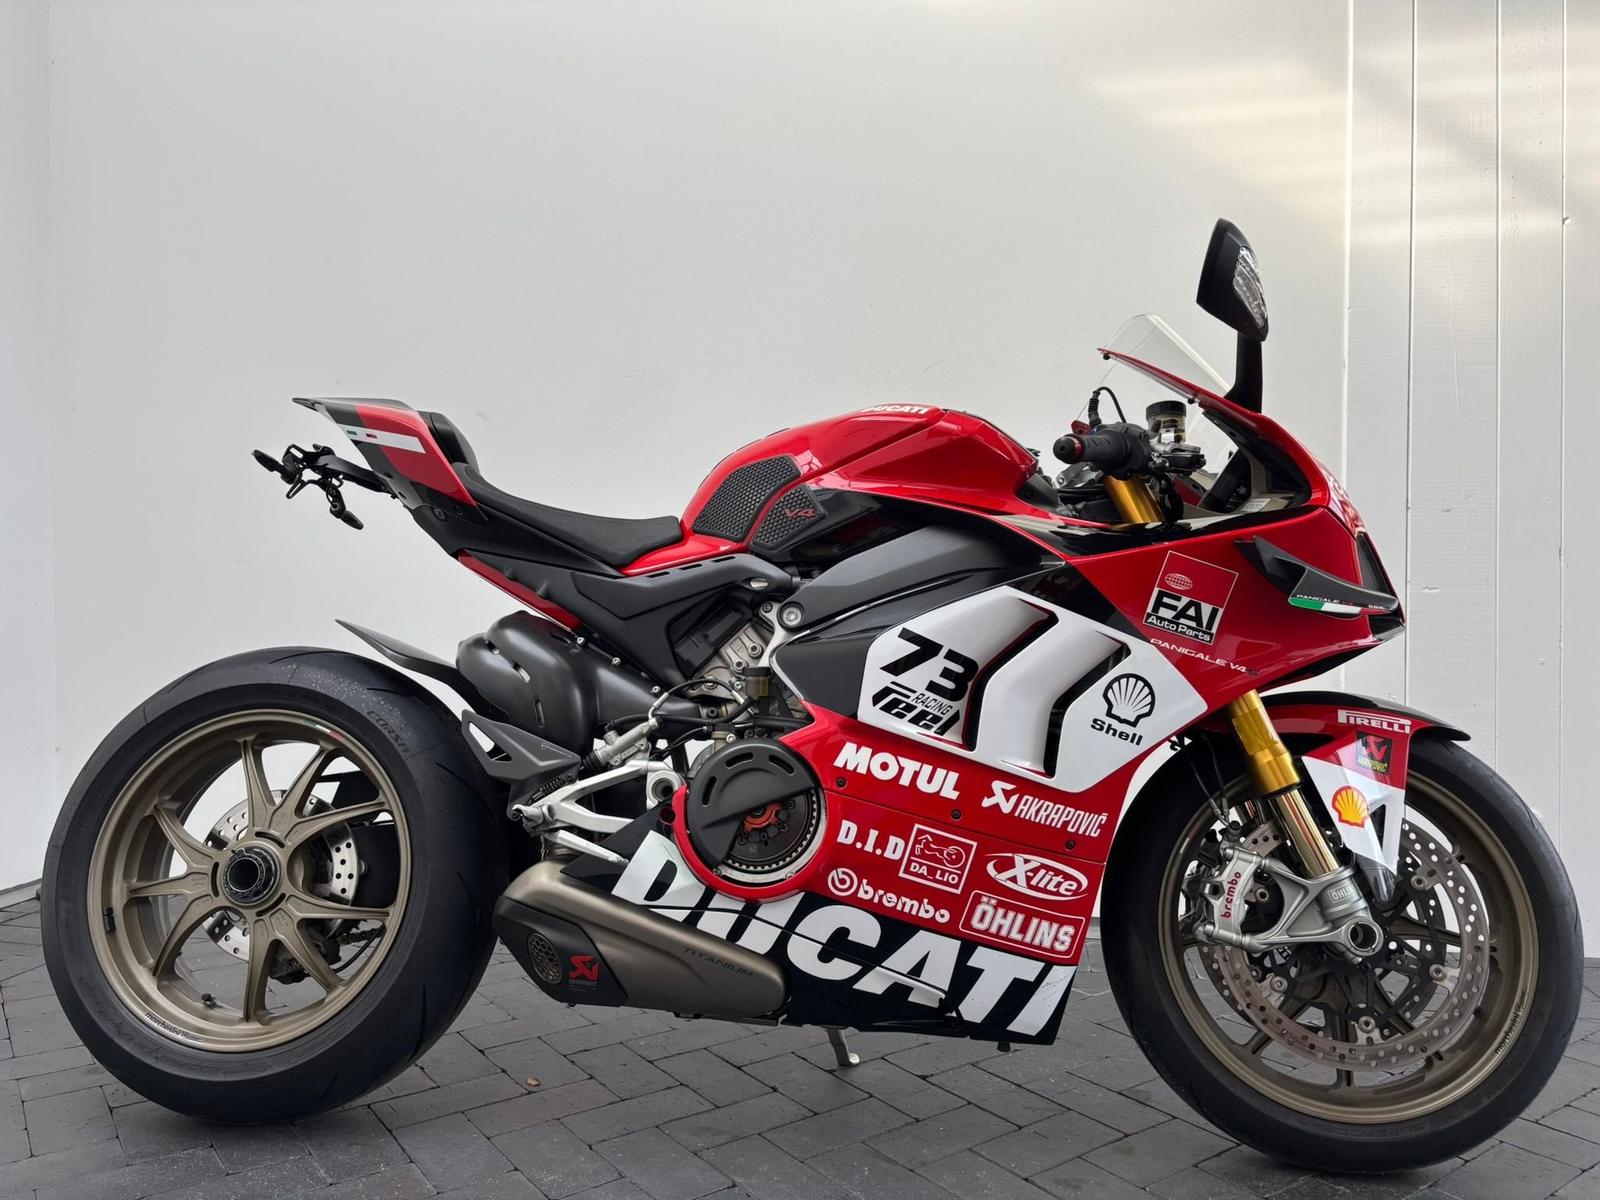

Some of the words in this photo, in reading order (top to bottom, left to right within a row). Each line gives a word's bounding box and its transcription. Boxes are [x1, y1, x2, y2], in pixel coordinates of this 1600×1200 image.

[784, 508, 817, 519] V4
[1147, 615, 1178, 631] Auto
[1178, 626, 1211, 642] Parts
[1150, 589, 1220, 632] FAI
[879, 627, 979, 703] 73
[1149, 638, 1230, 667] PANIGALE
[911, 693, 954, 716] RACING
[1337, 709, 1412, 734] PIRELLI
[1090, 717, 1144, 746] Shell
[833, 741, 961, 800] MOTUL
[836, 819, 905, 861] D.I.D
[994, 853, 1078, 896] X-lite
[1220, 871, 1242, 918] brembo
[857, 878, 951, 923] brembo
[611, 829, 1077, 1037] DUCATI
[970, 895, 1076, 952] ÖHLINS
